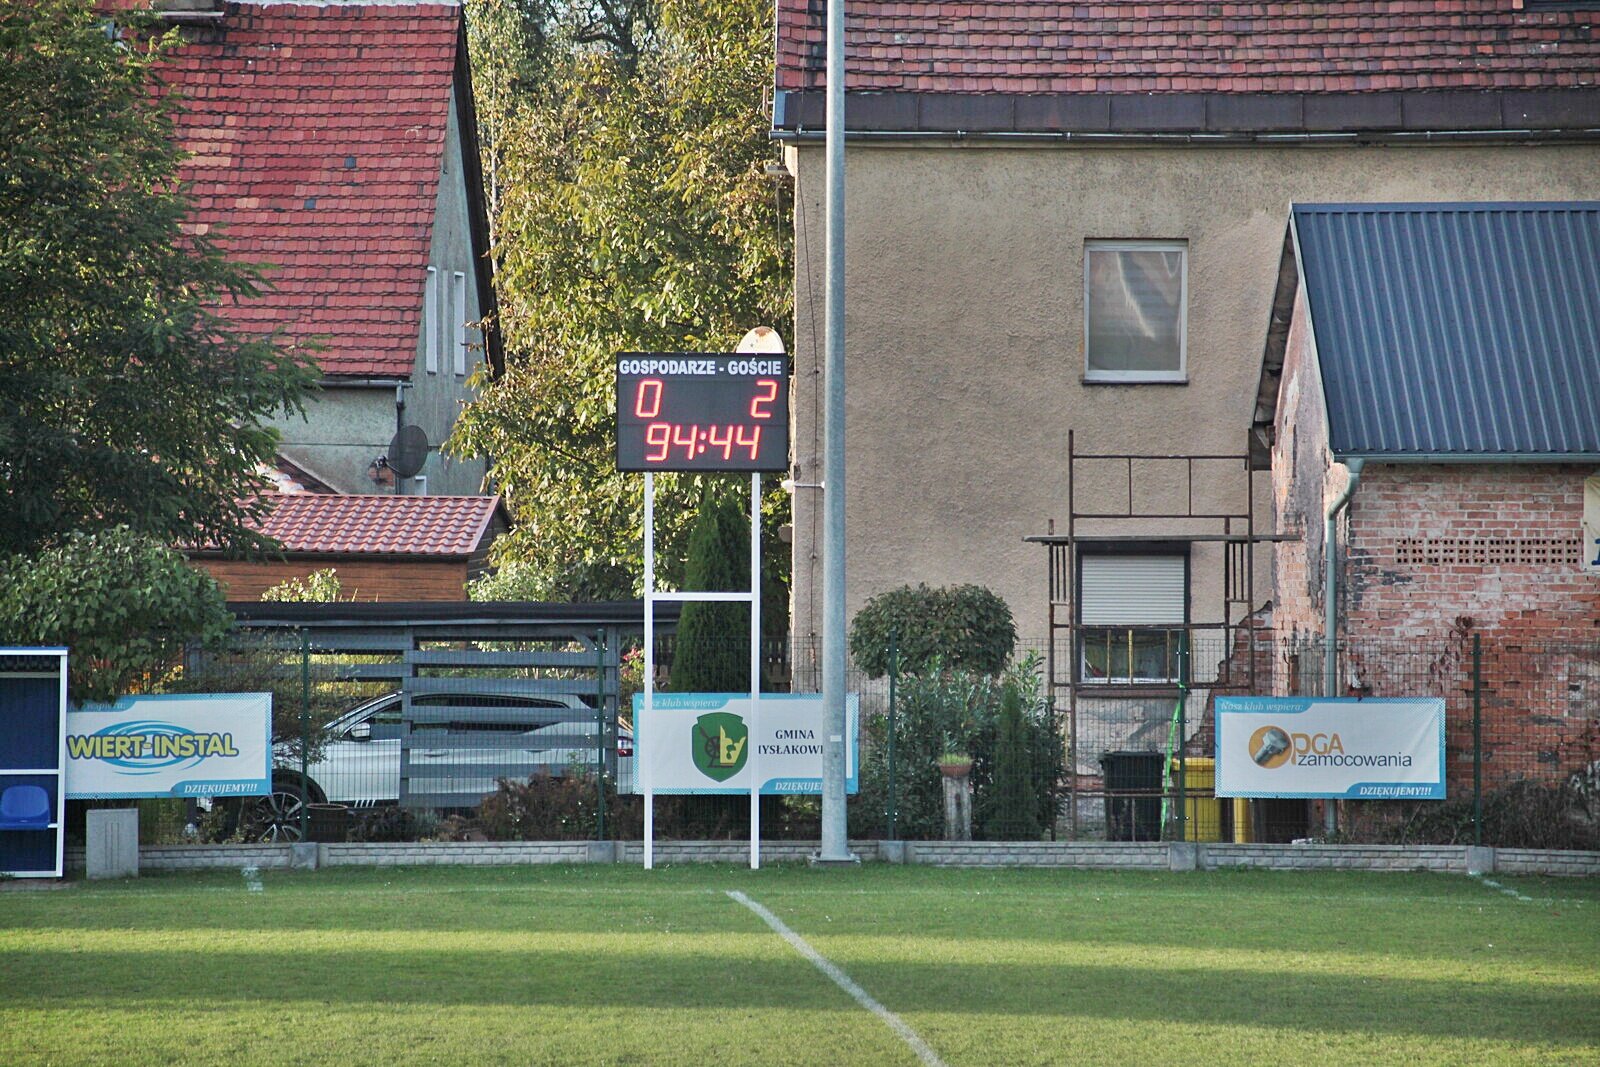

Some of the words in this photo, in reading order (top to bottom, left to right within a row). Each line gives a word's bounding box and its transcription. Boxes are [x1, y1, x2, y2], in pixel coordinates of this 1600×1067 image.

[619, 360, 716, 375] GOSPODARZE
[728, 357, 782, 375] GOŚCIE
[635, 379, 663, 418] 0
[750, 379, 778, 418] 2
[645, 423, 761, 461] 94:44
[662, 698, 681, 707] klub
[683, 699, 720, 709] wspiera:
[1244, 701, 1264, 711] klub
[1266, 702, 1304, 713] wspiera:
[775, 729, 815, 740] GMINA
[66, 732, 239, 759] WIERT-INSTAL
[758, 744, 823, 755] YSŁAKOWI
[1297, 752, 1412, 767] zamocowania
[184, 783, 258, 795] DZIĘKUJEMY!!!
[775, 782, 823, 792] DZIĘKUJE
[1359, 786, 1432, 798] DZIĘKUJEMY!!!
